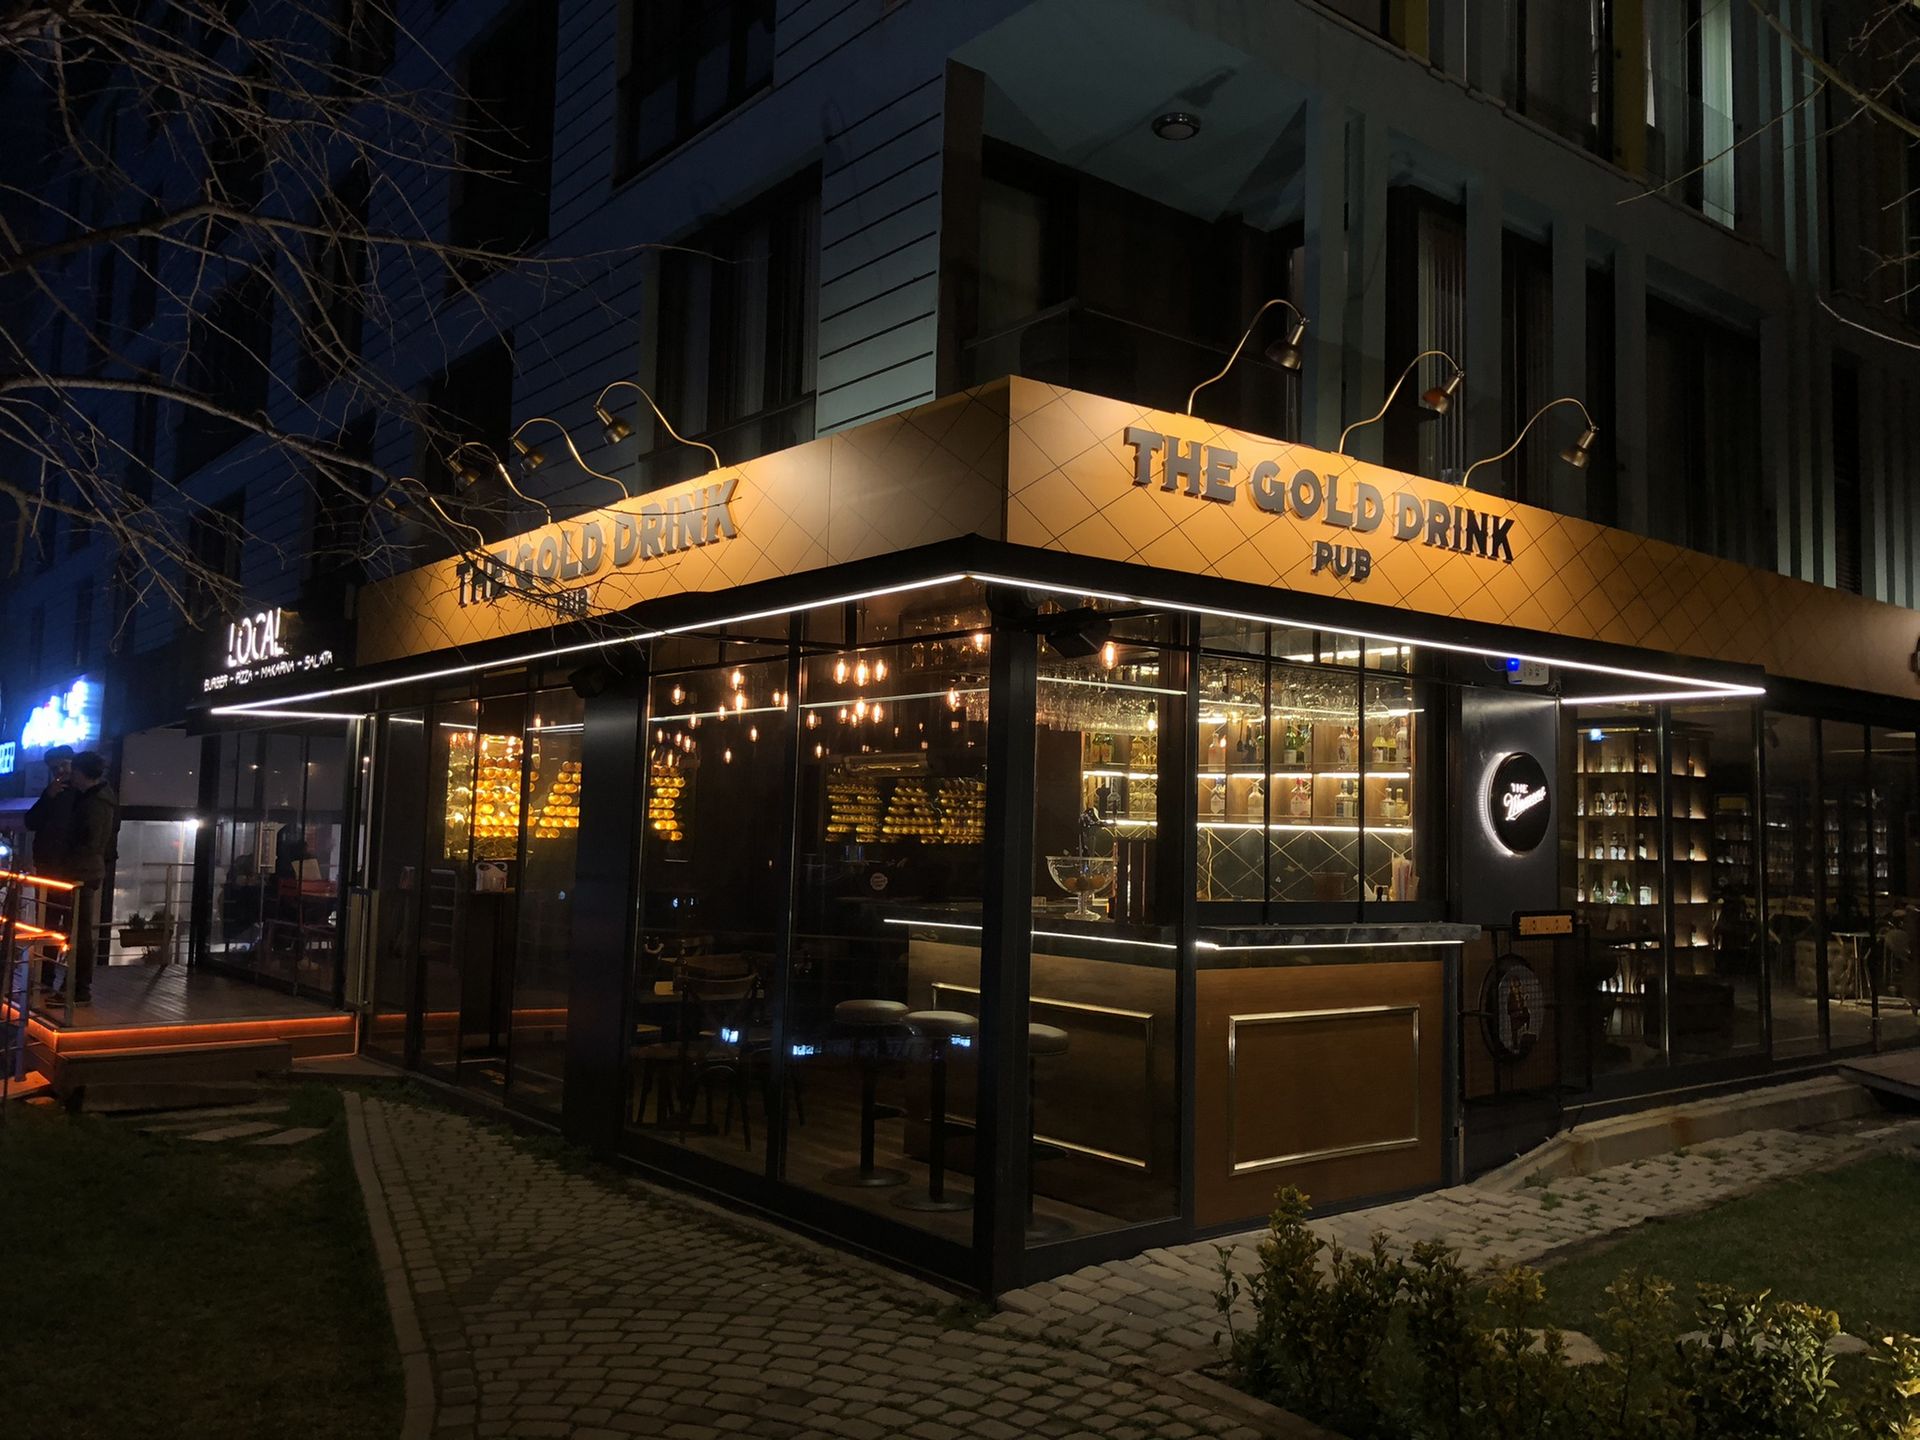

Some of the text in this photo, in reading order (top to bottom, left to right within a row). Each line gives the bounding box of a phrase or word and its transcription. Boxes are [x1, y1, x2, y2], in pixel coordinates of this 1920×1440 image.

[1123, 426, 1515, 564] THE GOLD DRINK
[456, 479, 739, 608] THE GOLD DRINK
[1310, 540, 1372, 582] PUB
[228, 607, 285, 668] LOCAL
[203, 650, 334, 692] BURGER PIZZA MAKARNA SALATA
[1510, 782, 1529, 794] THE
